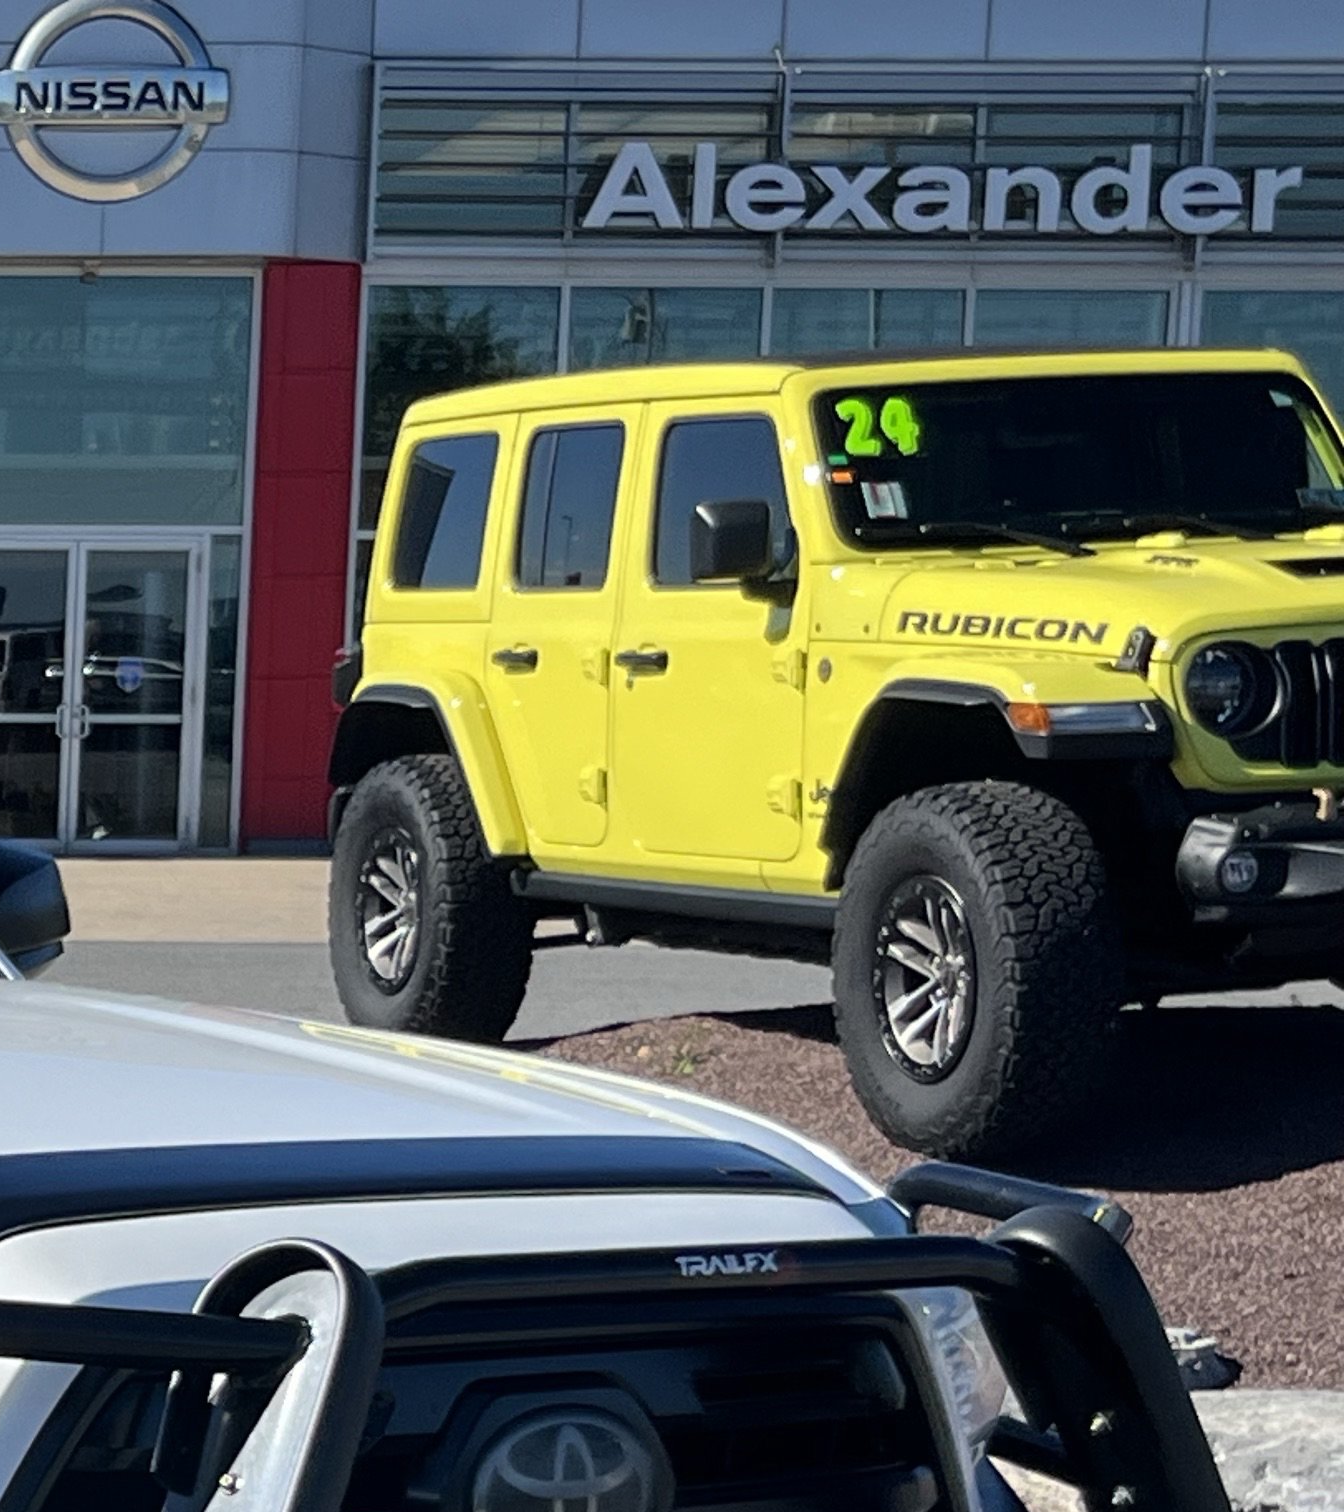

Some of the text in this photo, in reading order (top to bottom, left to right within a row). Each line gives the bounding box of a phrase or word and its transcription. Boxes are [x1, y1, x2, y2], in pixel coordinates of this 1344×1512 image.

[14, 80, 205, 113] NISSAN
[582, 142, 1303, 235] Alexander
[835, 397, 919, 456] 24
[896, 610, 1110, 645] RUBICON
[674, 1249, 779, 1277] TRAILFX
